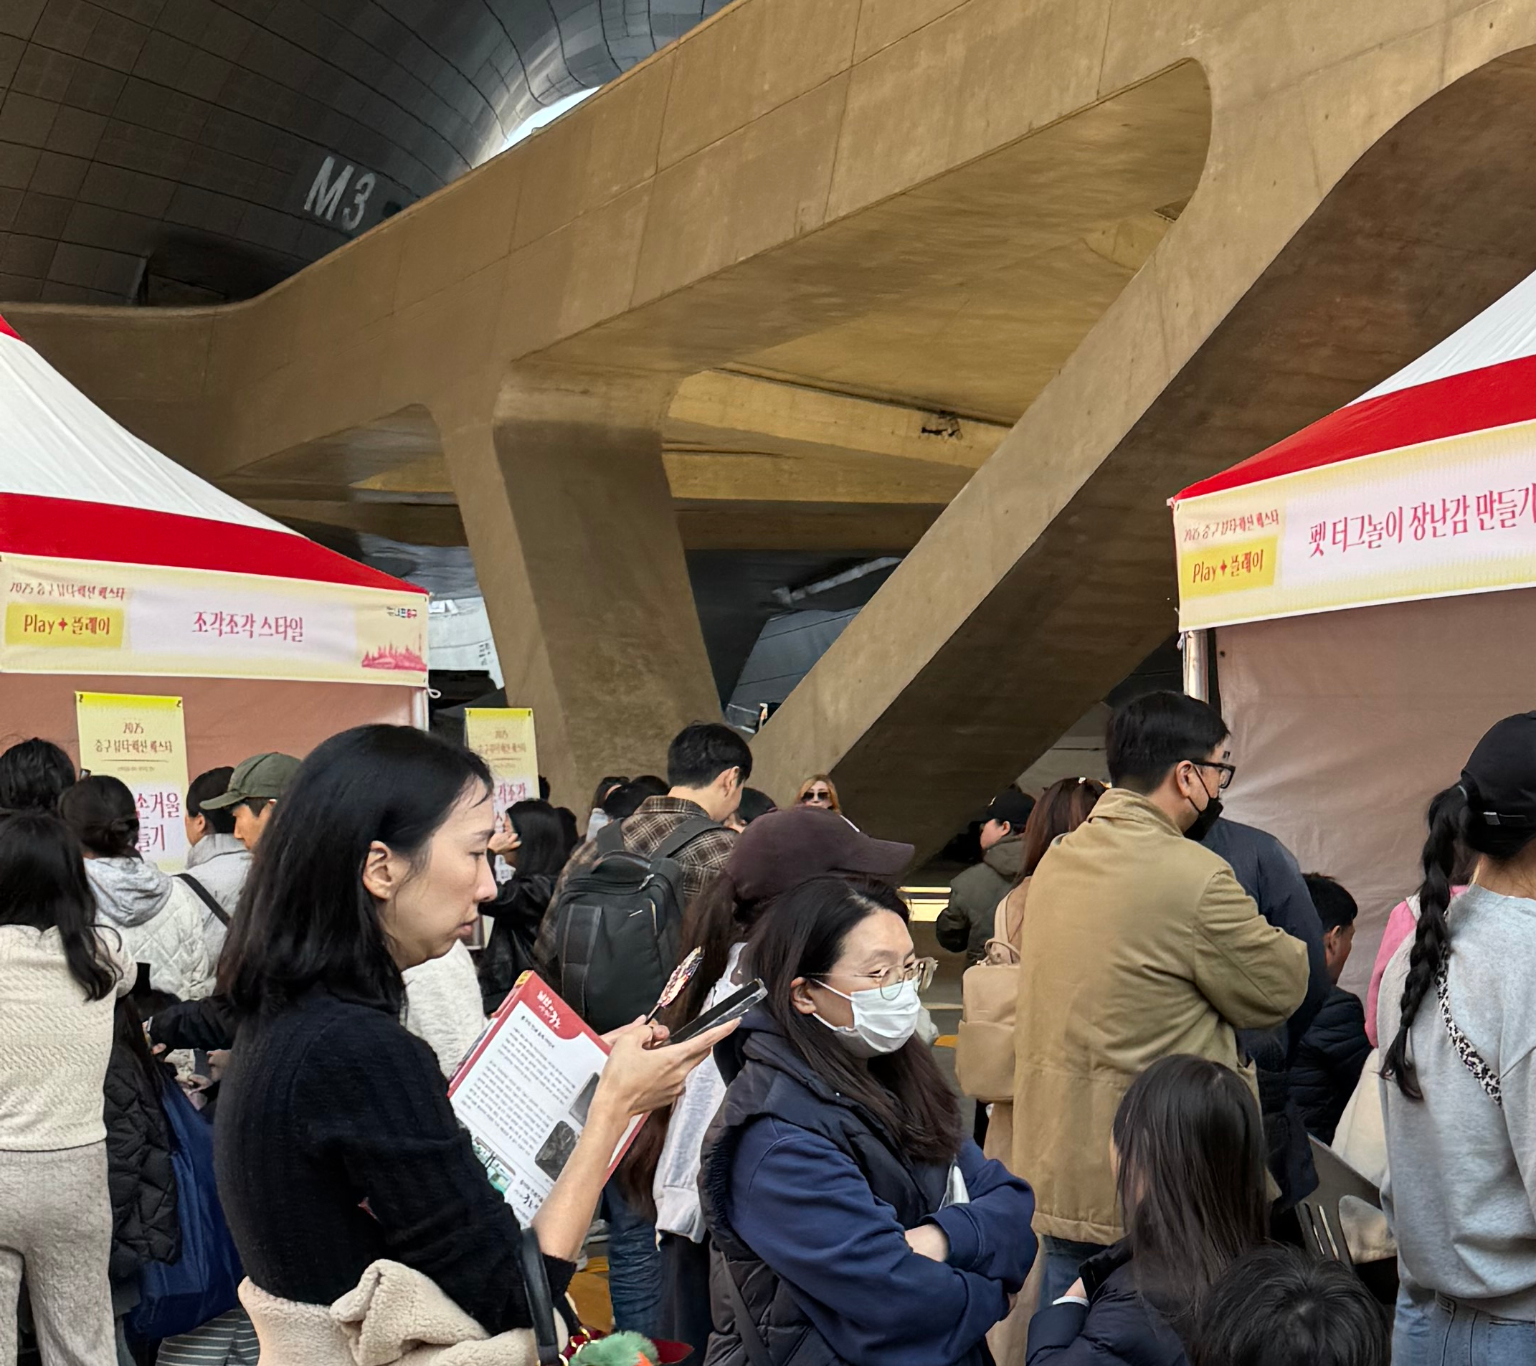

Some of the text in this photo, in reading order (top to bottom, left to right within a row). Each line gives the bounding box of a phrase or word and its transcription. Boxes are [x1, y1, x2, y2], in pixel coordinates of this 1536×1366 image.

[304, 156, 376, 231] M3
[1308, 522, 1327, 559] 펫
[1330, 504, 1405, 552] 터그놀이
[1409, 495, 1471, 542] 장난감
[1192, 560, 1217, 584] Play
[23, 614, 55, 635] Play
[192, 610, 304, 643] 조각조각 스타일
